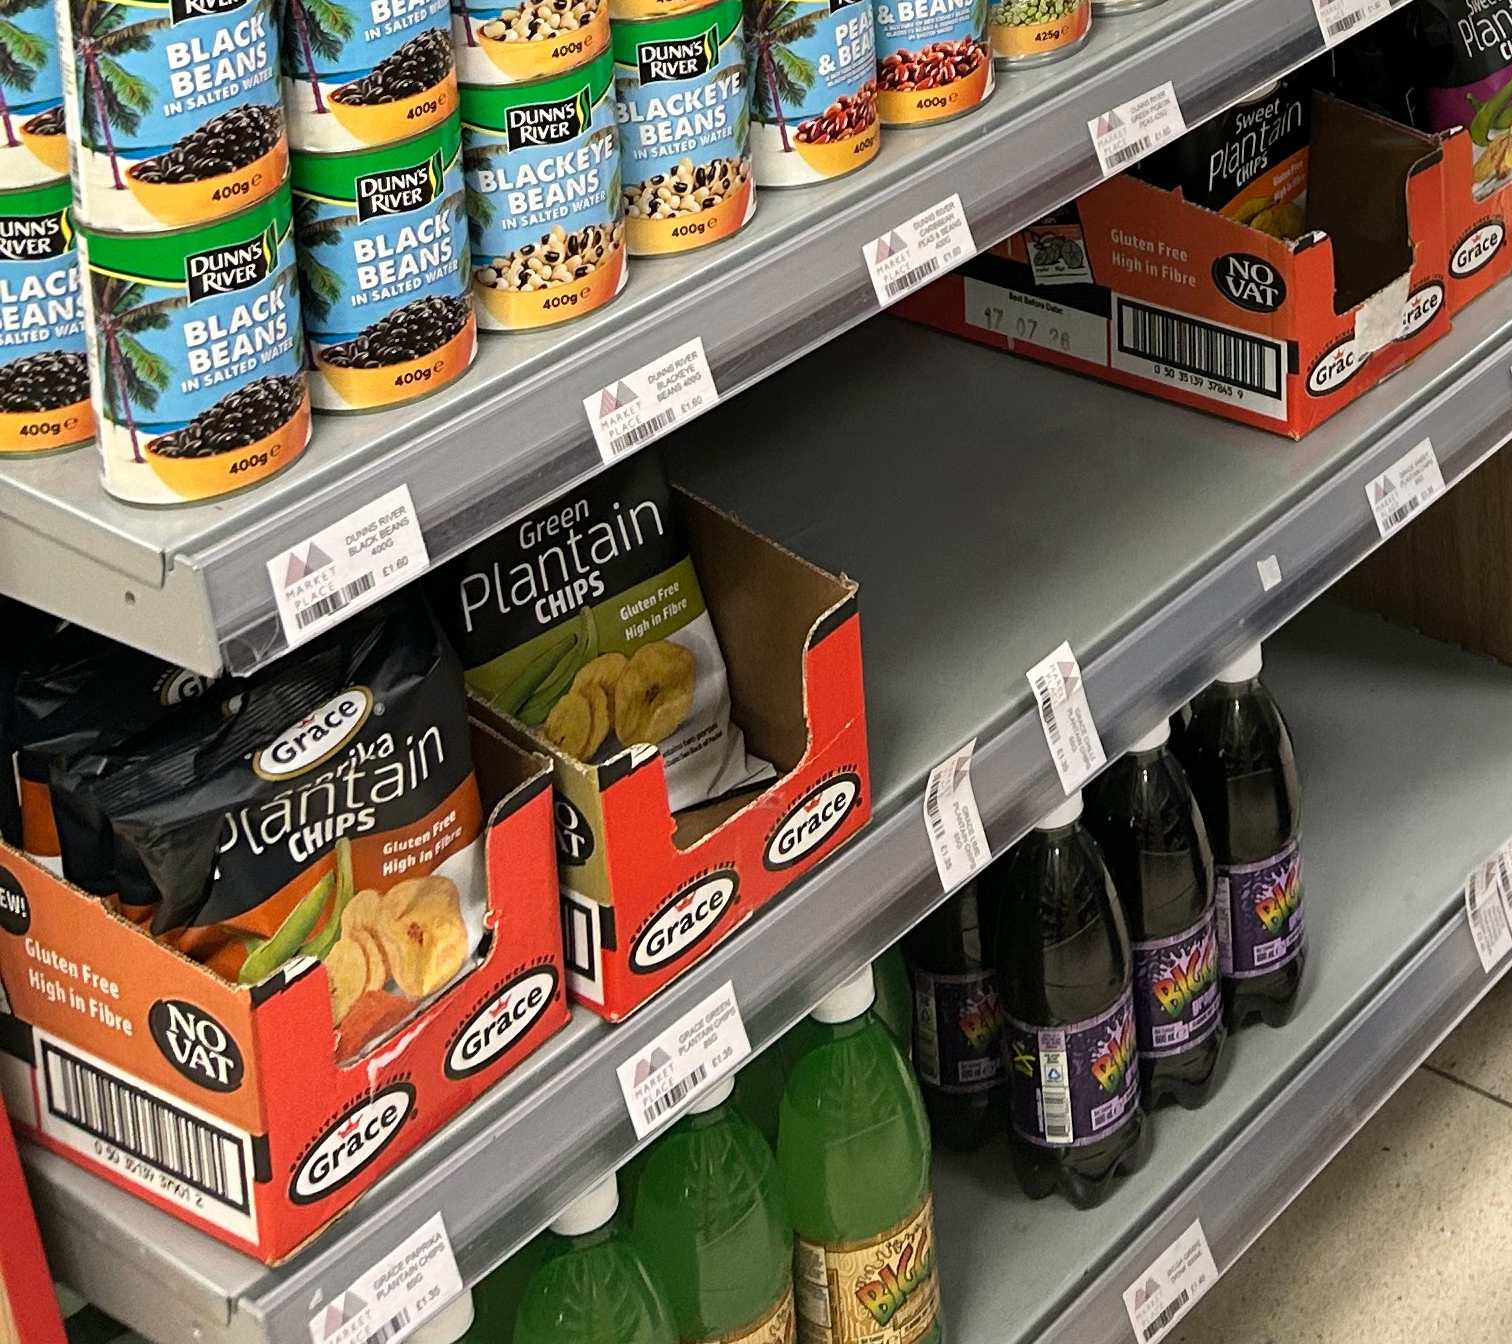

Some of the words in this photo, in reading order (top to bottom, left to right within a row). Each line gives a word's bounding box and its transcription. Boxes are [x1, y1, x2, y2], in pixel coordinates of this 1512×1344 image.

[877, 4, 896, 25] &
[166, 17, 266, 72] BLACK
[1034, 28, 1061, 45] 425g
[170, 47, 268, 98] BEANS
[509, 103, 575, 129] DUNN'S
[916, 93, 947, 111] 400g
[1235, 97, 1280, 136] Sweet
[520, 123, 570, 144] RIVER
[1207, 99, 1302, 192] Plantain
[360, 165, 429, 199] DUNN'S
[478, 134, 614, 193] BLACKEYE
[1236, 153, 1268, 188] CHIPS
[210, 178, 250, 205] 400g
[371, 189, 425, 216] RIVER
[501, 219, 518, 231] IN
[522, 206, 569, 227] SALTED
[572, 191, 606, 212] WATER
[507, 170, 599, 214] BEANS
[353, 213, 452, 264] BLACK
[1110, 229, 1155, 254] Gluten
[1158, 240, 1189, 263] Free
[356, 237, 454, 289] BEANS
[1111, 252, 1143, 276] High
[1145, 262, 1160, 277] in
[1161, 264, 1197, 288] Fibre
[1228, 257, 1274, 283] NO
[542, 294, 578, 310] 400g
[1225, 278, 1278, 307] VAT
[394, 366, 432, 388] 400g
[1206, 380, 1233, 397] 37845
[19, 420, 61, 438] 400g
[379, 506, 406, 525] RIVER
[518, 497, 591, 550] Green
[348, 533, 377, 557] BLACK
[379, 517, 410, 539] BEANS
[371, 540, 394, 556] 400G
[286, 567, 336, 600] MARKET
[459, 497, 664, 632] Plantain
[294, 583, 335, 608] PLACE
[534, 570, 606, 625] CHIPS
[619, 591, 656, 622] Gluten
[656, 580, 680, 604] Free
[624, 615, 650, 641] High
[650, 612, 663, 627] in
[663, 596, 689, 623] Fibre
[287, 806, 376, 864] CHIPS
[382, 830, 430, 857] Gluten
[432, 809, 457, 835] Free
[777, 788, 847, 855] Grace
[645, 887, 724, 959] Grace
[24, 936, 79, 977] Gluten
[82, 967, 120, 999] Free
[28, 968, 66, 1005] High
[69, 991, 86, 1014] in
[89, 999, 133, 1037] Fibre
[166, 1002, 227, 1053] NO
[460, 985, 543, 1062] Grace
[165, 1030, 235, 1085] VAT
[306, 1100, 399, 1186] Grace
